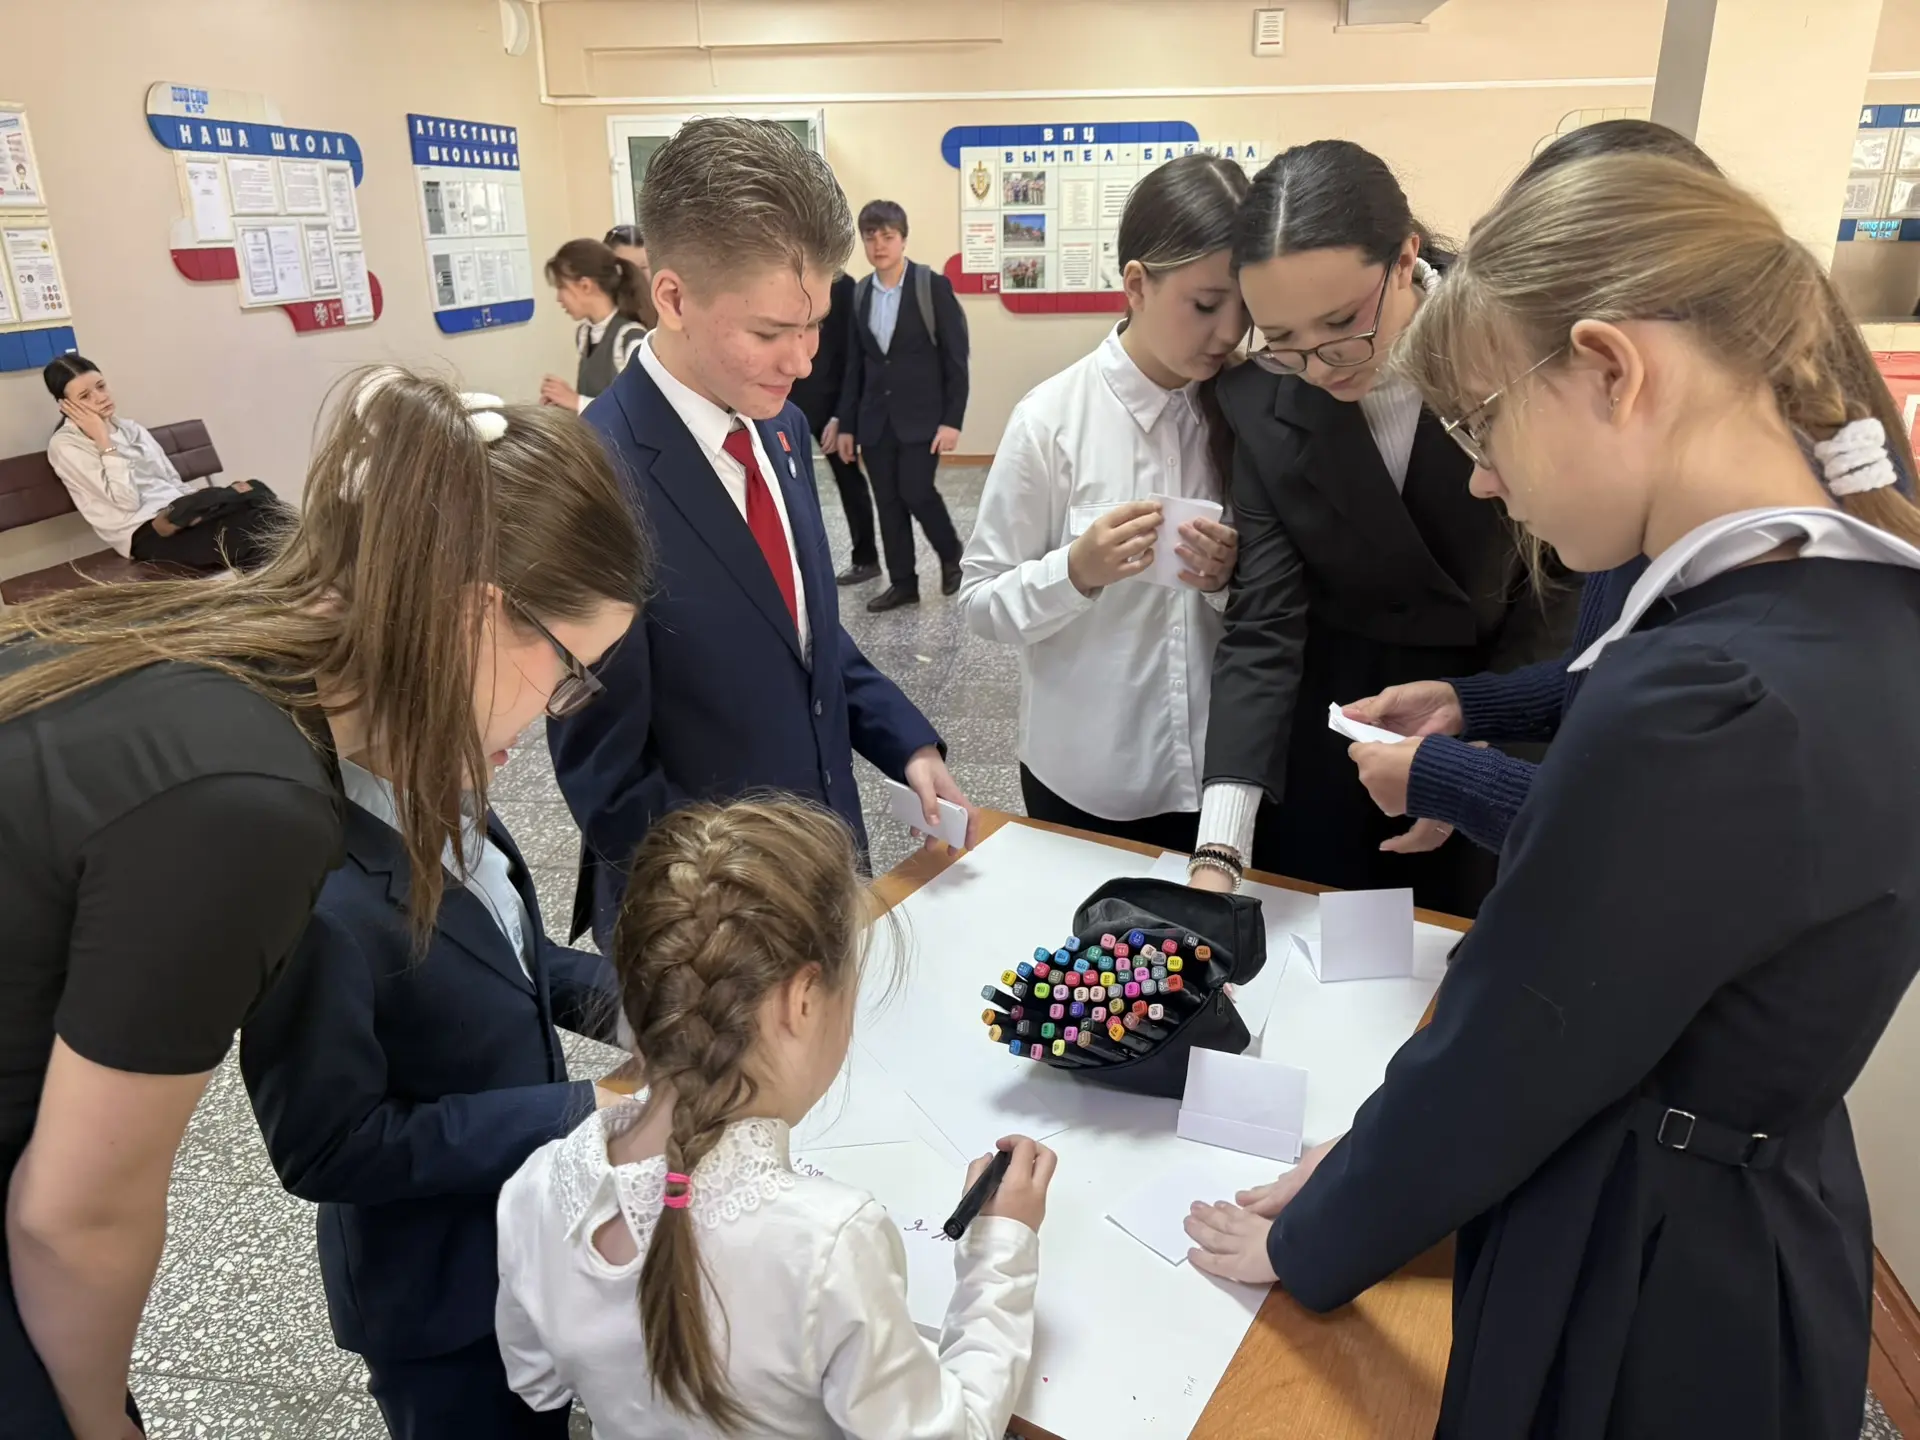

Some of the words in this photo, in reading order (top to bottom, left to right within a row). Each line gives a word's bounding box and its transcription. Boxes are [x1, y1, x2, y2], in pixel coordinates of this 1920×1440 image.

[179, 124, 249, 147] НАША
[270, 132, 345, 155] ШКОЛА
[416, 119, 516, 145] АТТЕСТАЦИЯ
[428, 145, 518, 167] ШКОЛЬНИКА
